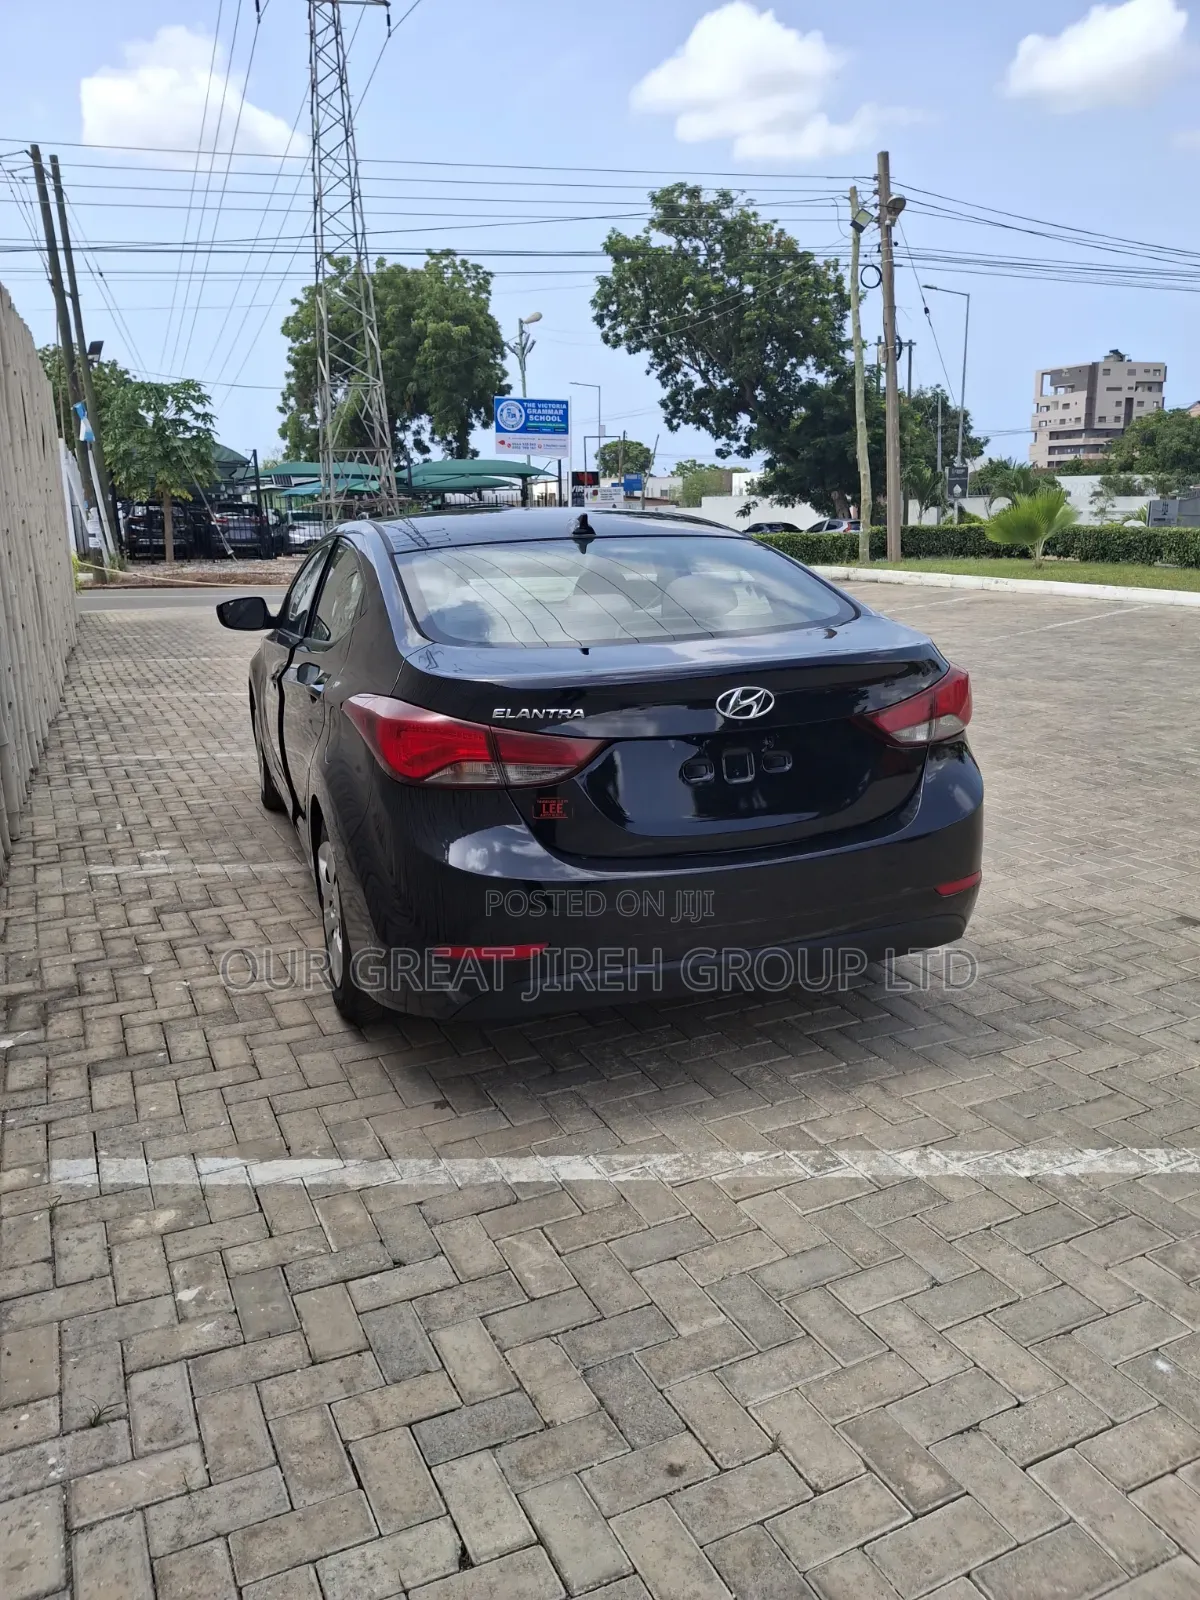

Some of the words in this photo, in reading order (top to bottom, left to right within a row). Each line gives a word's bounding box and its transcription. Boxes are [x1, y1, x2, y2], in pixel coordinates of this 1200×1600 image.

[529, 414, 562, 422] SCHOOL
[492, 708, 585, 719] ELANTRA
[542, 803, 563, 814] LEE
